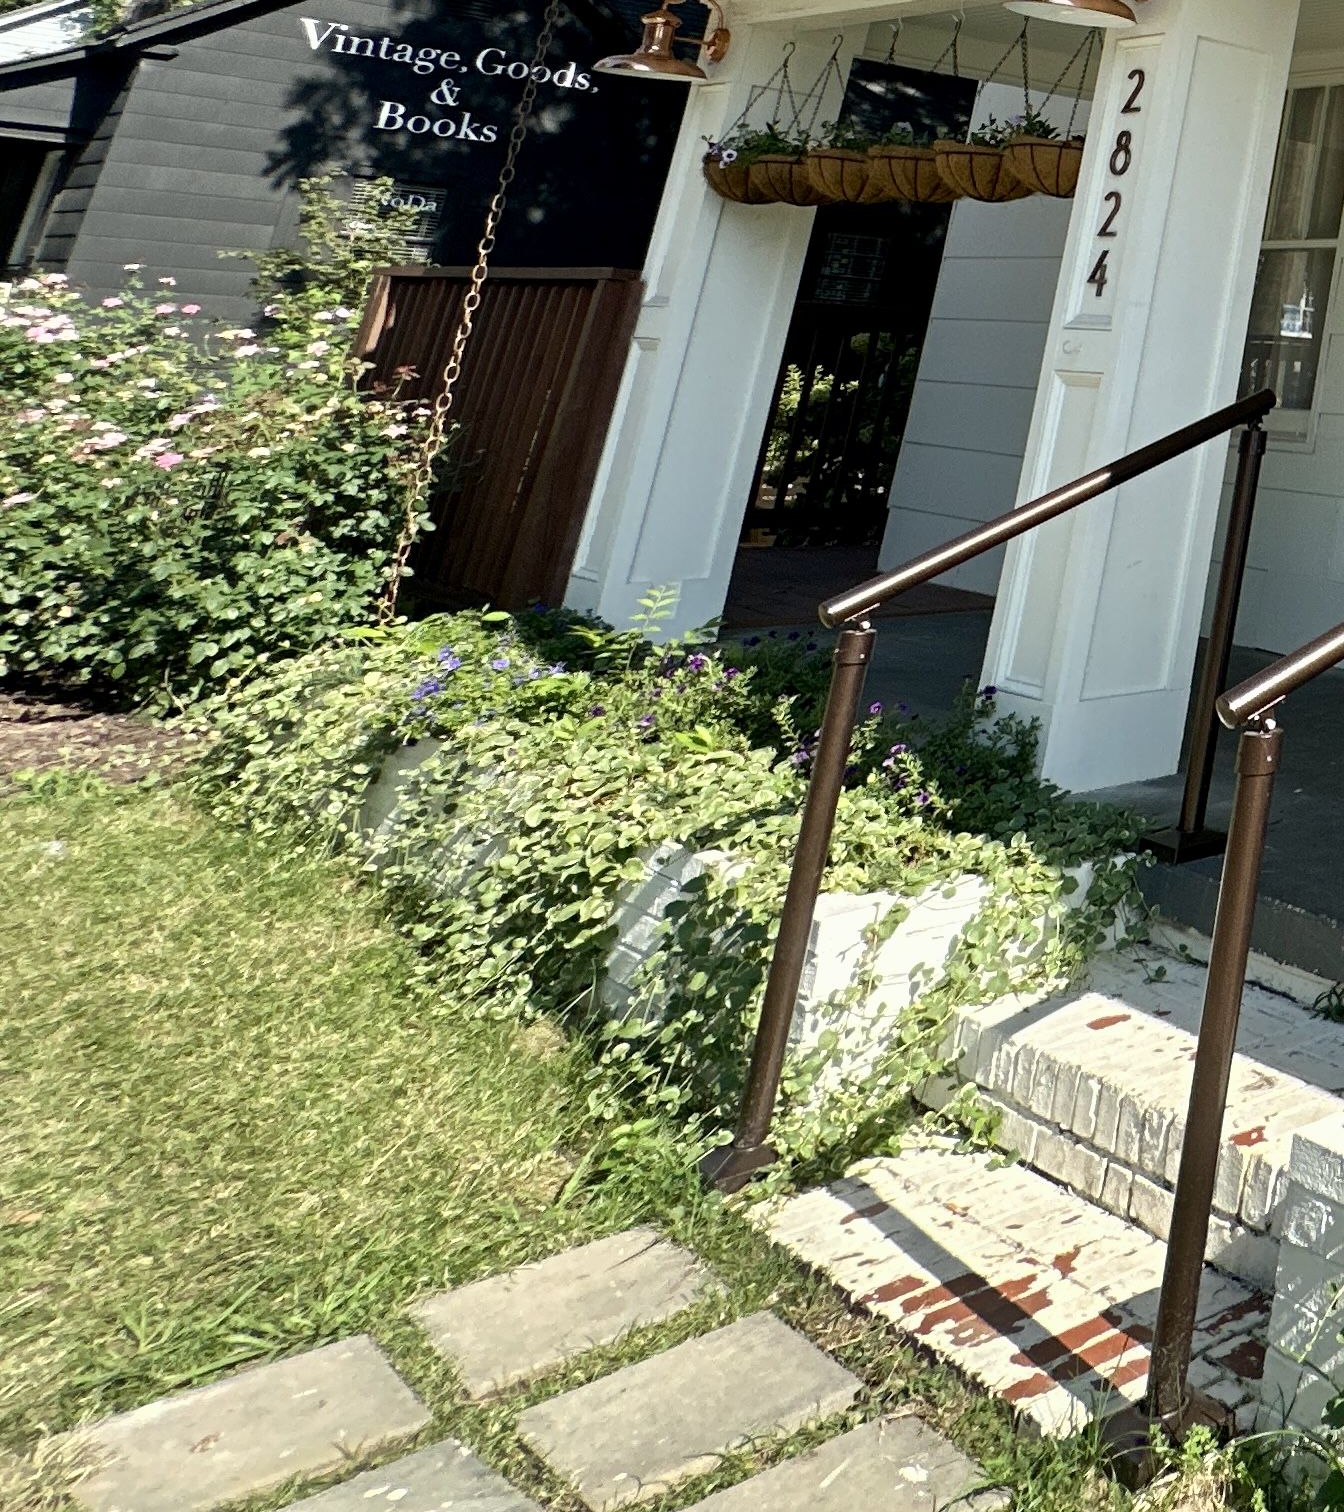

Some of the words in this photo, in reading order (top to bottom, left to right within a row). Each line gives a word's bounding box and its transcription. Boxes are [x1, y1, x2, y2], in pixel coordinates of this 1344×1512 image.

[300, 17, 468, 75] Vintage,
[475, 47, 599, 93] Goods,
[372, 100, 498, 143] Books
[430, 78, 460, 106] &
[1086, 69, 1145, 297] 2824
